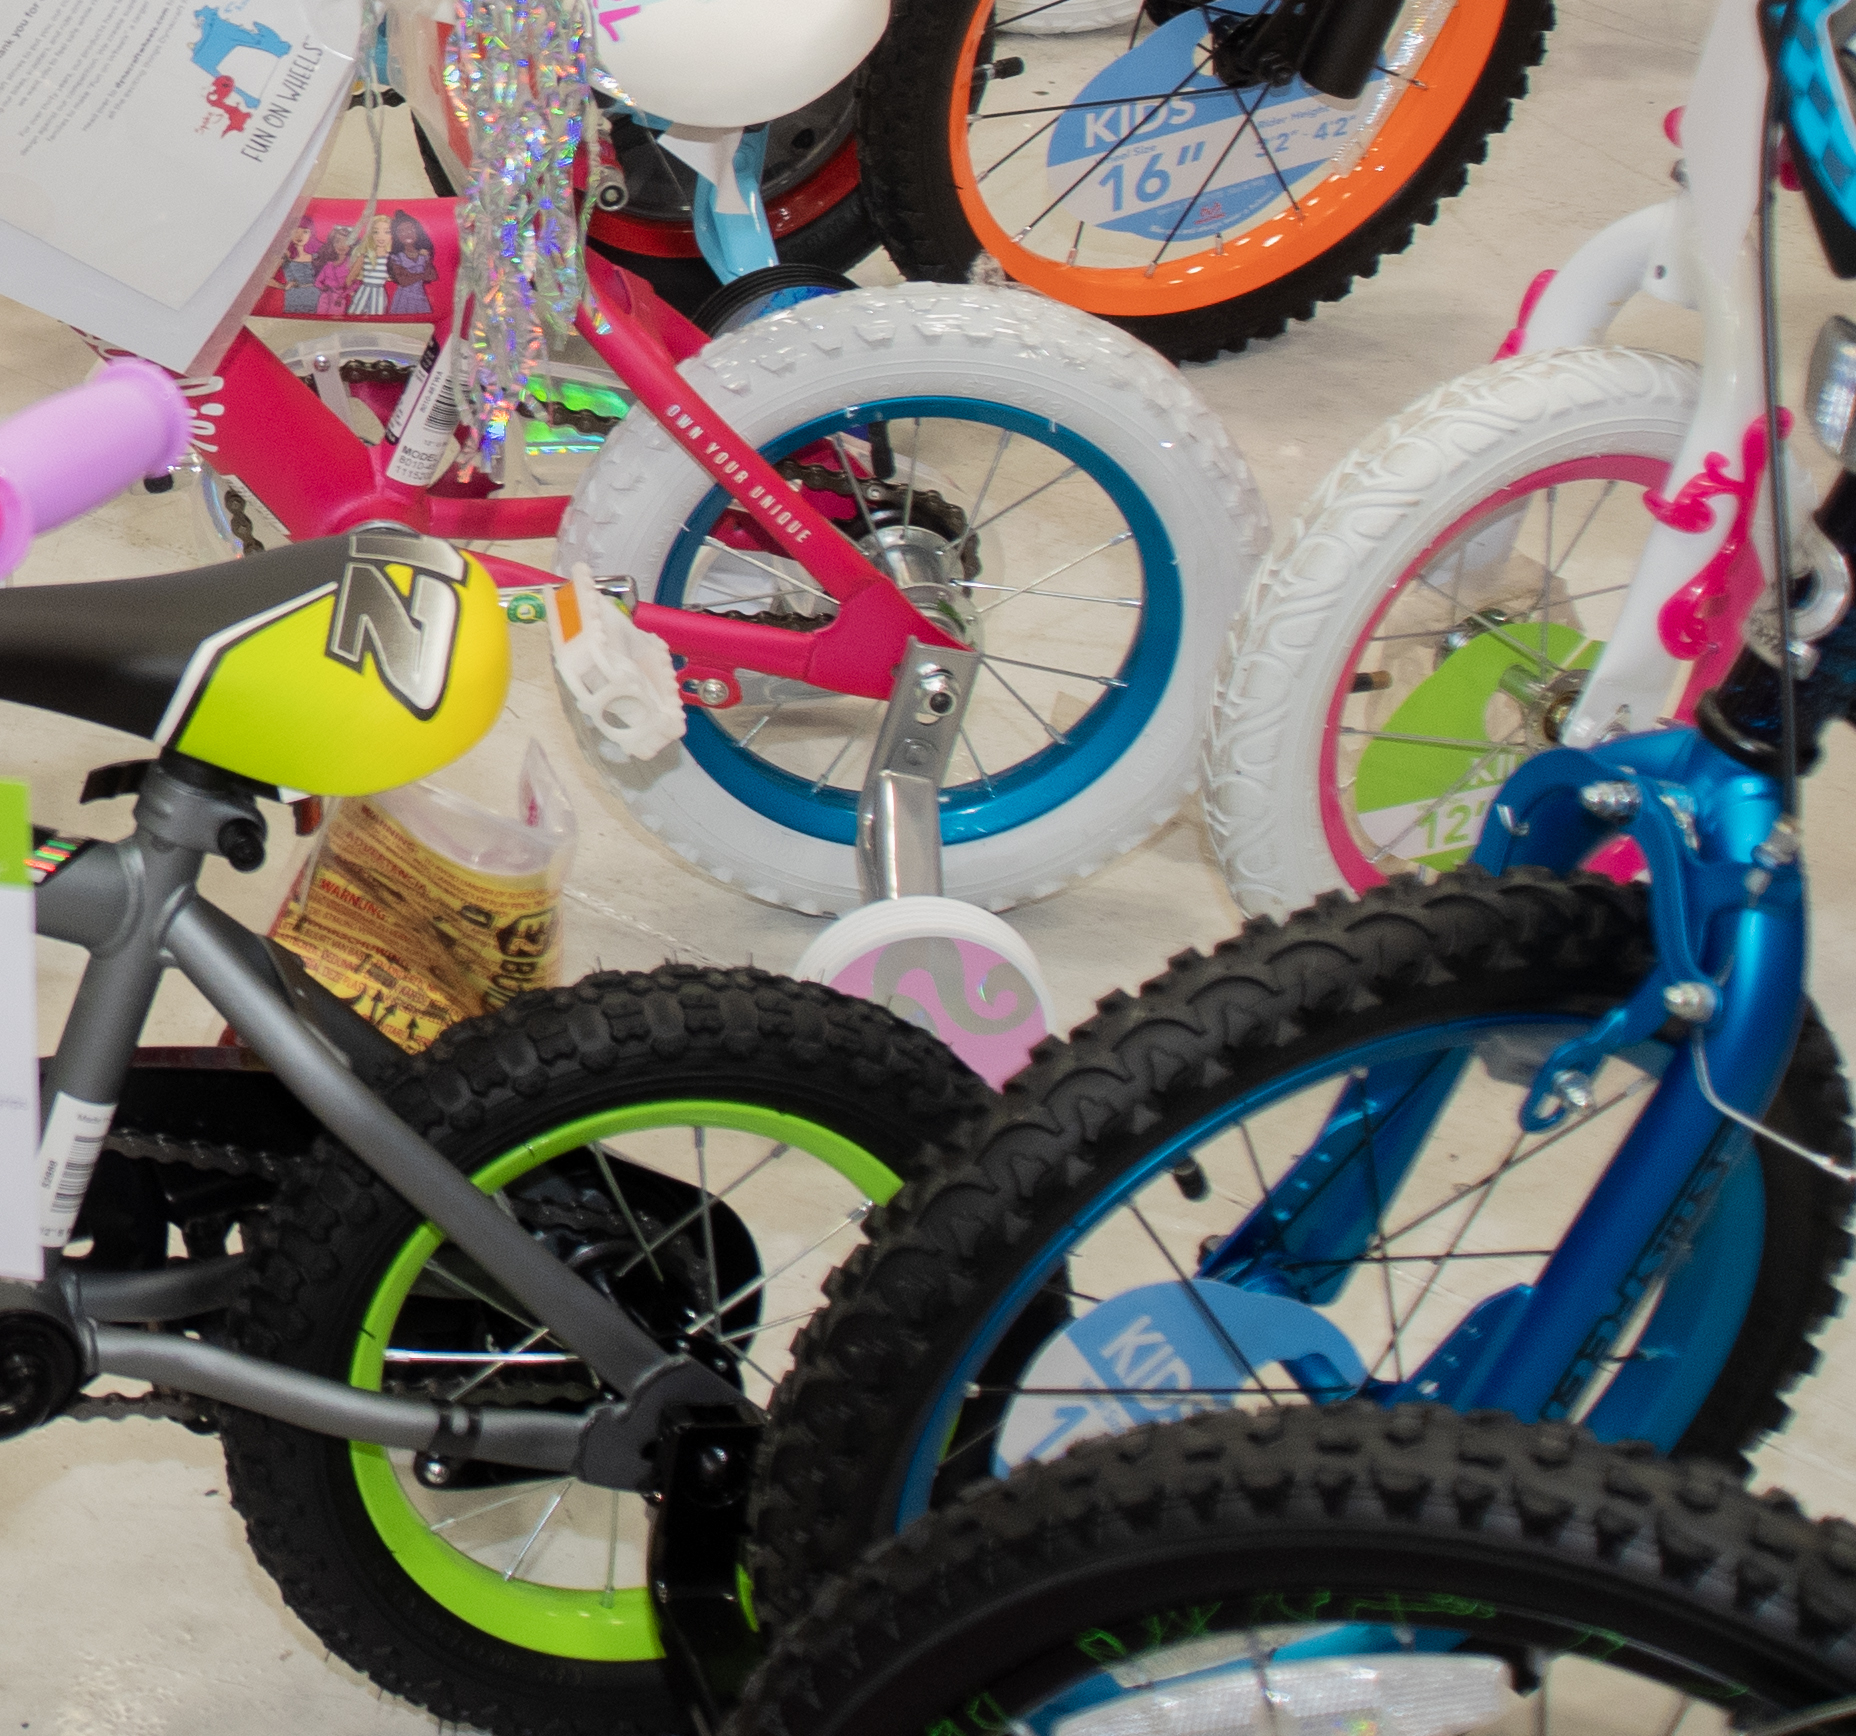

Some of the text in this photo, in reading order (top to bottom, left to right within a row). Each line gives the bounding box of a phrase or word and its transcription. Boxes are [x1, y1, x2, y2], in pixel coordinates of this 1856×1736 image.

[10, 16, 30, 40] you
[22, 0, 41, 20] for
[241, 42, 323, 162] FUN ON WHEELS
[1078, 85, 1201, 149] KIDS
[1093, 140, 1216, 214] 16"
[666, 402, 812, 546] OWN YOUR UNIQUE
[320, 878, 386, 920] WARNUNG
[1095, 1311, 1201, 1424] KID
